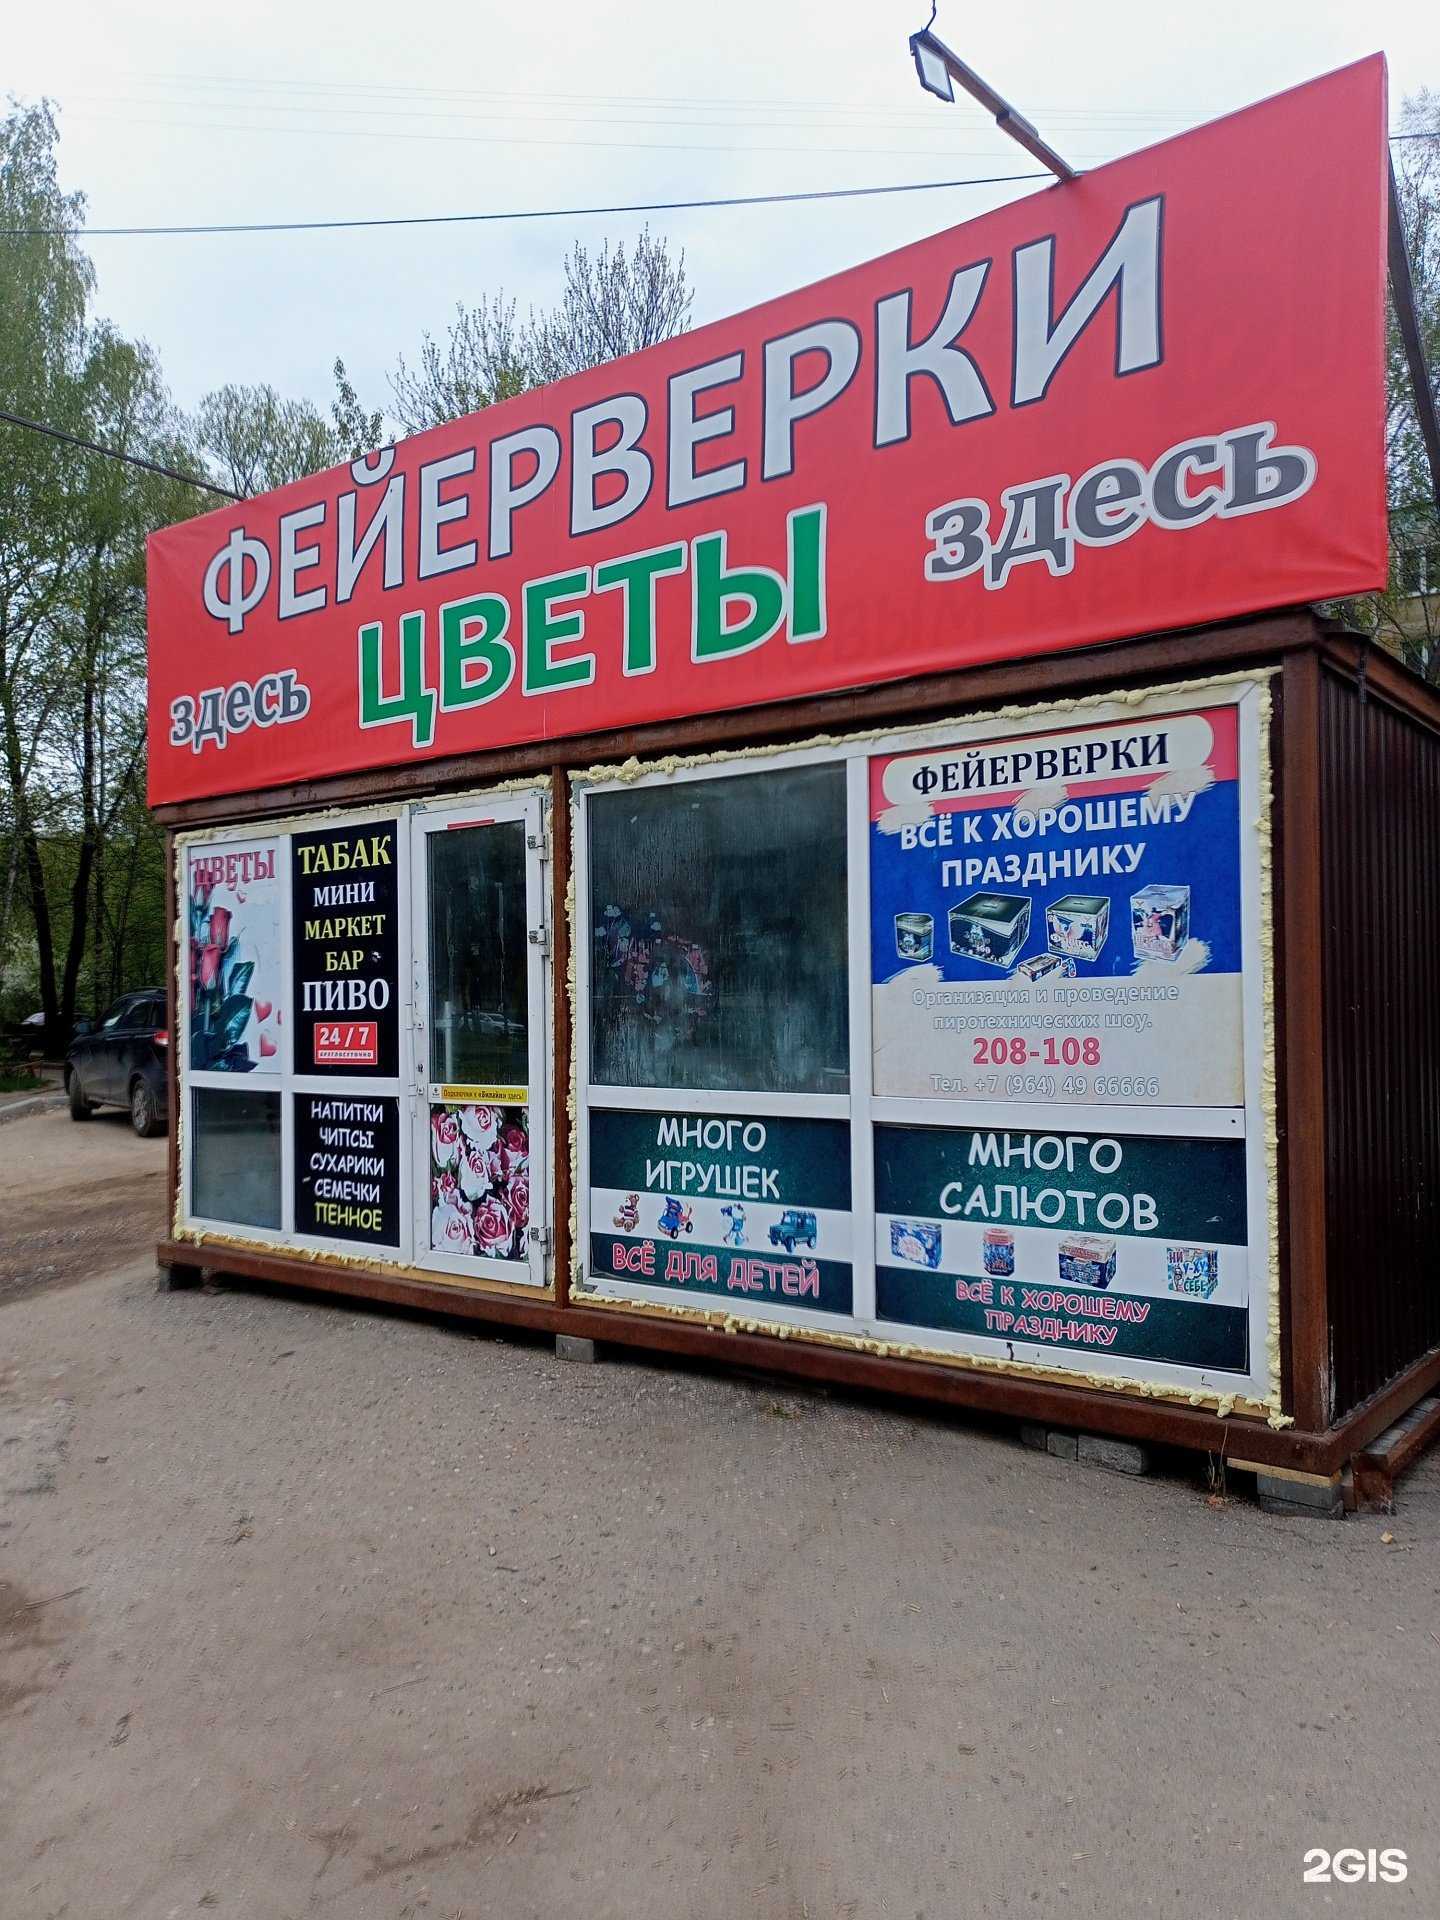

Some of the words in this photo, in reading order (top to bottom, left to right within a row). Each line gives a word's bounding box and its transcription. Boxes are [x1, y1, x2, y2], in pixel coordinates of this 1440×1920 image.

[201, 195, 1166, 634] ФЕЙЕРВЕРКИ
[924, 420, 1318, 590] здесь
[357, 503, 829, 748] ЦВЕТЫ
[168, 667, 312, 754] здесь
[912, 732, 1170, 796] ФЕЙЕРВЕРКИ
[900, 815, 953, 850] ВСЁ
[963, 816, 982, 844] К
[992, 791, 1197, 842] ХОРОШЕМУ
[298, 835, 392, 875] ТАБАК
[941, 842, 1146, 888] ПРАЗДНИКУ
[313, 881, 375, 908] МИНИ
[304, 914, 386, 941] МАРКЕТ
[325, 951, 364, 972] БАР
[302, 978, 390, 1012] ПИВО
[912, 987, 1029, 1006] Организация
[1037, 988, 1047, 1002] и
[1053, 985, 1179, 1006] проведение
[933, 1013, 1099, 1031] пиротехнических
[1105, 1012, 1153, 1029] шоу.
[972, 1037, 1101, 1066] 208-108
[930, 1074, 968, 1093] Тел.
[975, 1075, 999, 1093] +7
[1005, 1074, 1056, 1096] (964)
[1062, 1076, 1088, 1095] 49
[1093, 1076, 1160, 1097] 66666
[311, 1100, 384, 1123] НАПИТКИ
[319, 1127, 375, 1149] ЧИПСЫ
[656, 1117, 767, 1153] МНОГО
[968, 1132, 1123, 1174] МНОГО
[310, 1152, 385, 1178] СУХАРИКИ
[645, 1158, 780, 1200] ИГРУШЕК
[314, 1178, 380, 1203] СЕМЕЧКИ
[939, 1181, 1157, 1231] САЛЮТОВ
[315, 1202, 383, 1231] ПЕННОЕ
[612, 1239, 656, 1276] ВСЁ
[665, 1249, 718, 1283] ДЛЯ
[728, 1258, 820, 1299] ДЕТЕЙ
[955, 1278, 993, 1305] ВСЁ
[1001, 1288, 1015, 1309] К
[1021, 1290, 1151, 1324] ХОРОШЕМУ
[985, 1309, 1118, 1347] ПРАЗДНИКУ
